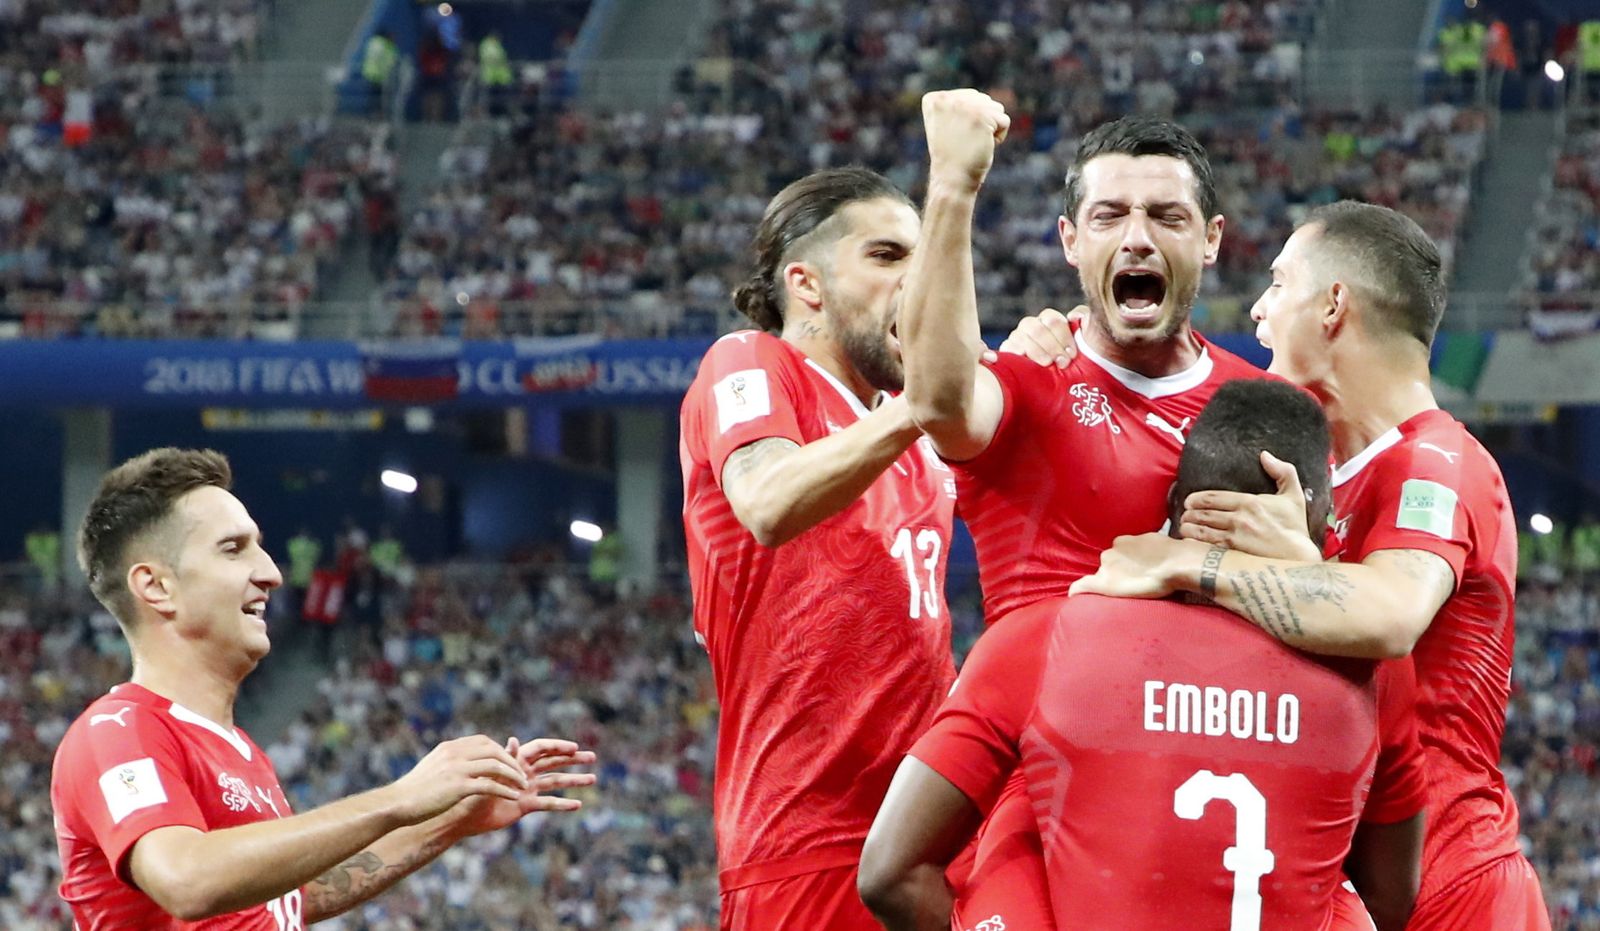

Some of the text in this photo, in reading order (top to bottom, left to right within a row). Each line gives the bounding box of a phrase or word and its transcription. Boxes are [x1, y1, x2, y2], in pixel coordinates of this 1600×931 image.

[145, 358, 234, 393] 2018
[238, 358, 325, 393] FIFA
[890, 528, 941, 619] 13
[1144, 680, 1299, 744] EMBOLO
[1173, 769, 1275, 931] 7
[266, 888, 302, 931] 18
